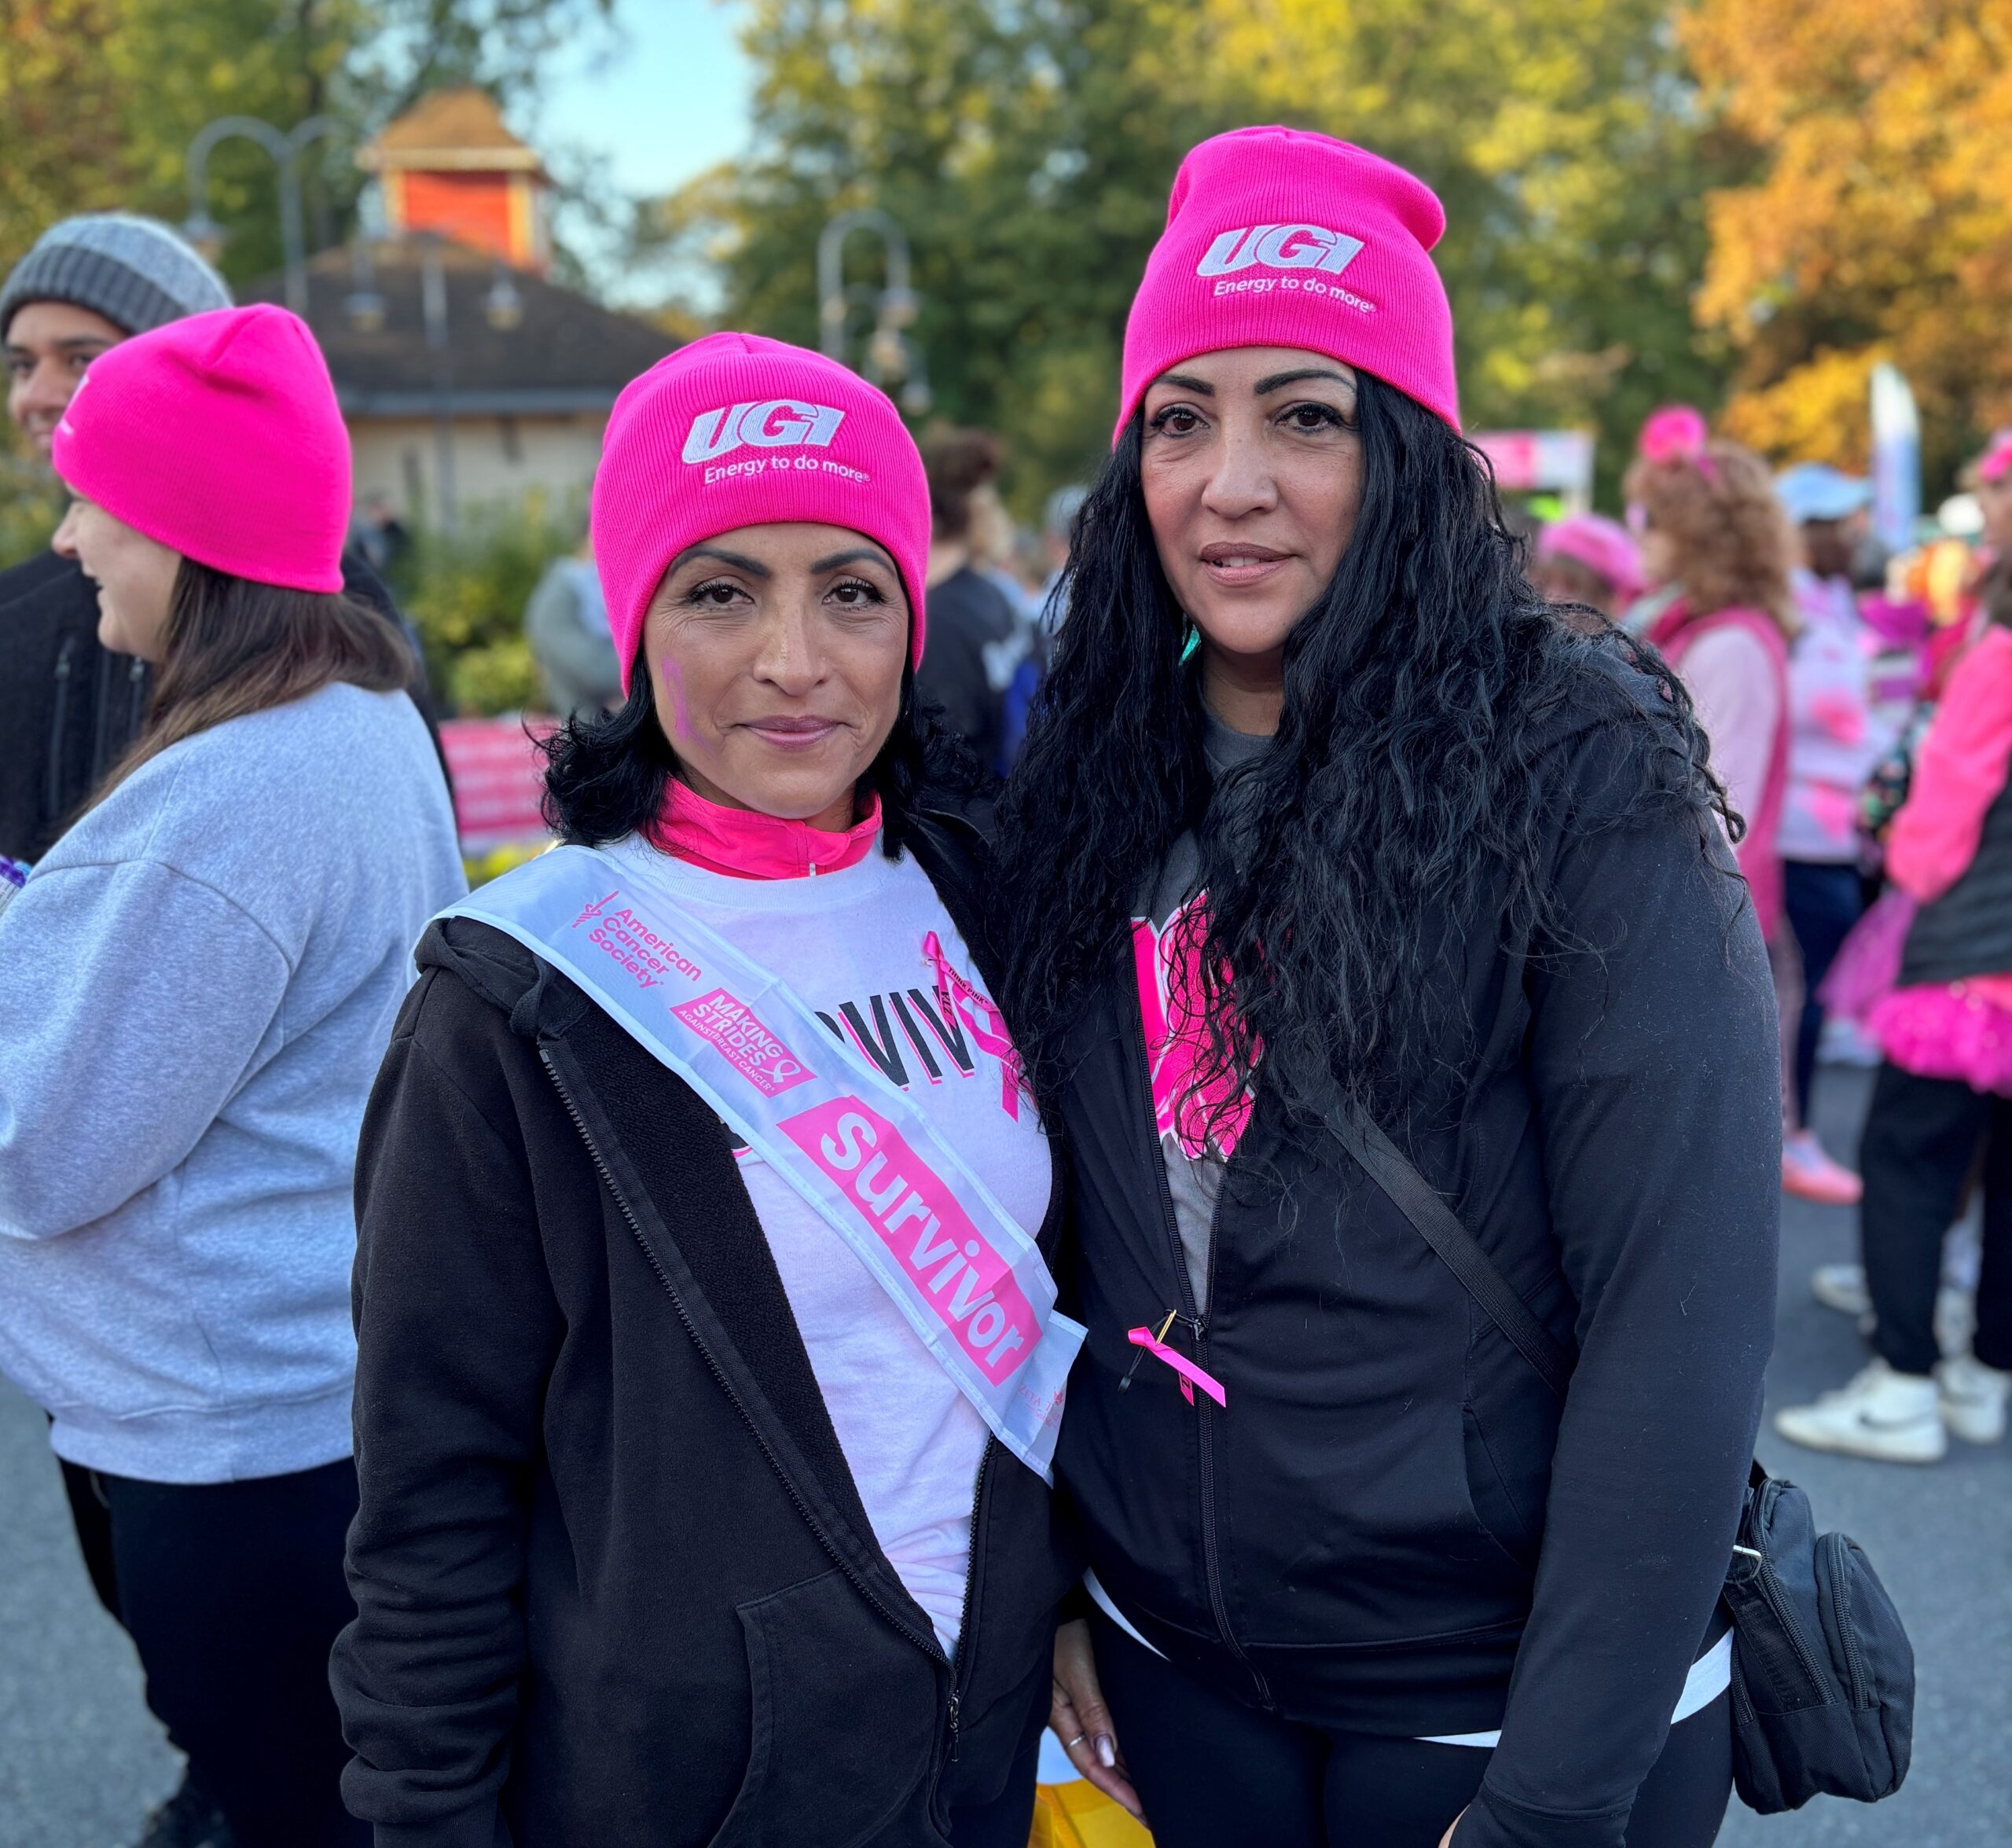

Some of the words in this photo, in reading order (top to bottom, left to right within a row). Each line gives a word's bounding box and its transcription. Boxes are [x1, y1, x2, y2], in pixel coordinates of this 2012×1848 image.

[1197, 224, 1365, 277] UGI
[1214, 277, 1274, 296] Energy
[1280, 276, 1299, 289] to
[1303, 277, 1327, 294] do
[681, 399, 845, 464] UGI
[704, 457, 766, 484] Energy
[771, 455, 790, 469] to
[794, 454, 818, 470] do
[589, 928, 659, 988] Society
[603, 917, 670, 974] Cancer
[615, 909, 702, 982] American
[967, 988, 985, 1004] PINK
[678, 1010, 717, 1038] AGAINST
[712, 1032, 741, 1063] BREAST
[692, 1003, 767, 1067] STRIDES
[709, 994, 784, 1058] MAKING
[821, 1112, 1024, 1369] Survivor
